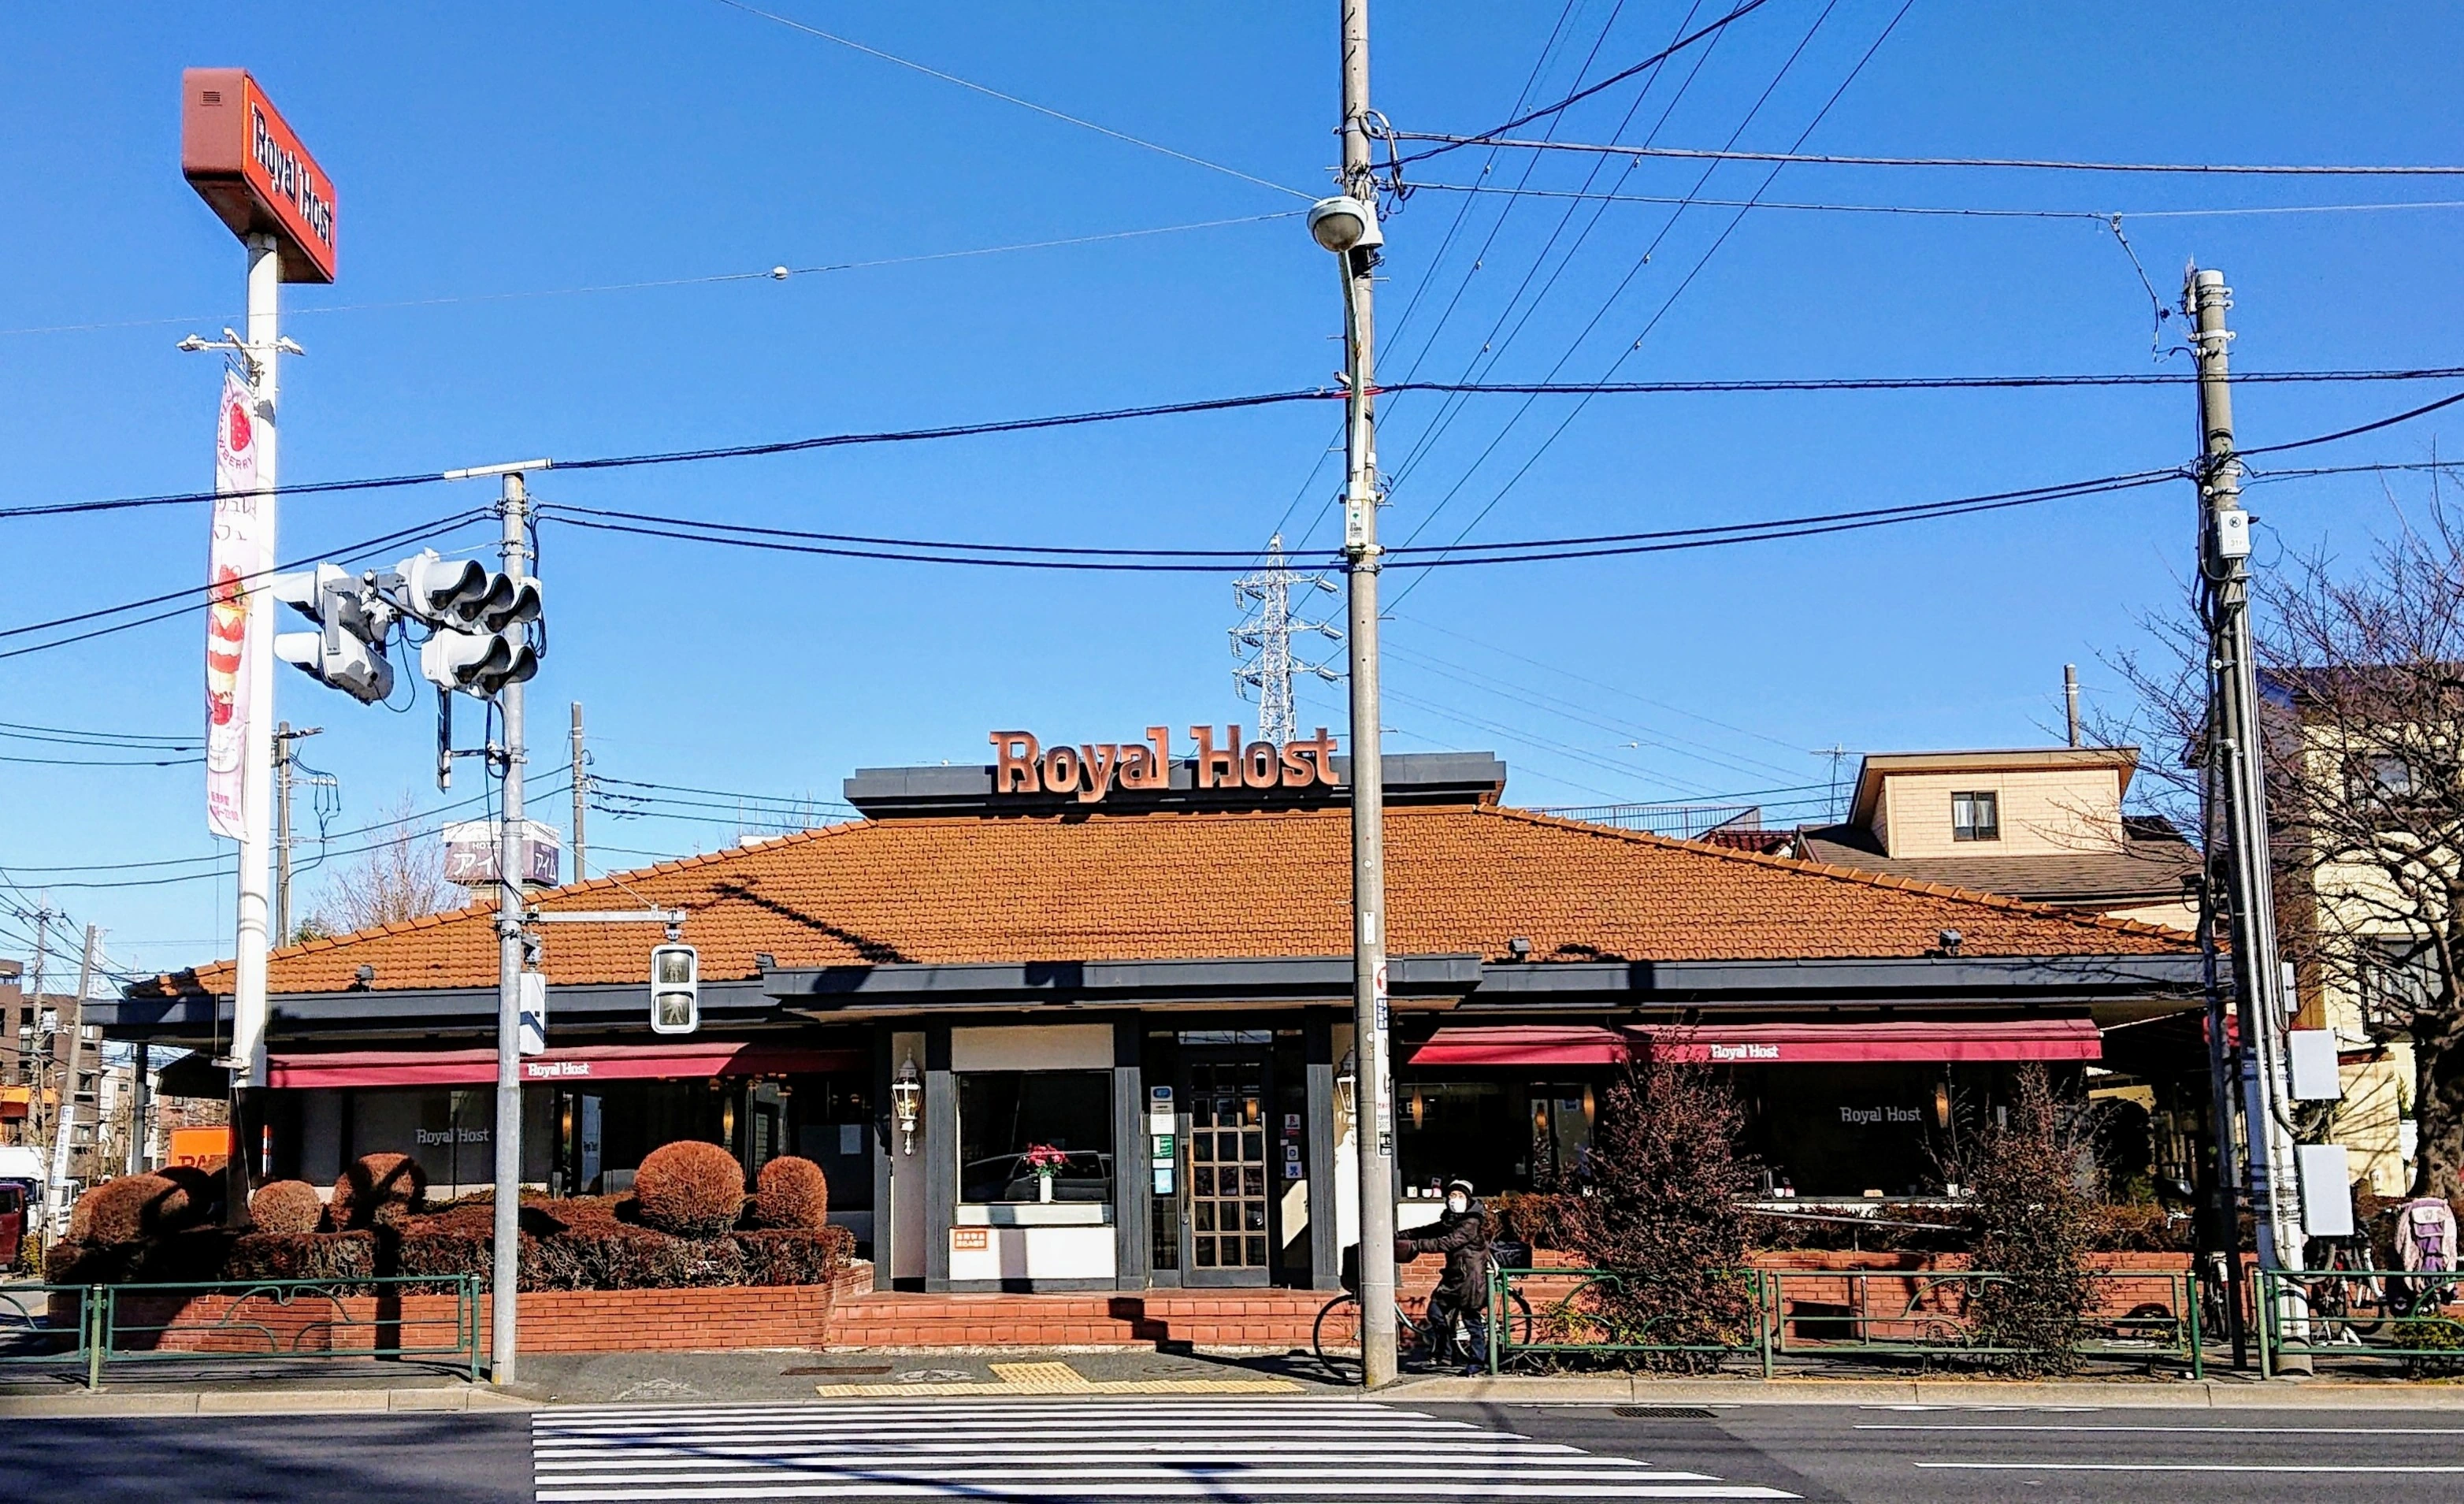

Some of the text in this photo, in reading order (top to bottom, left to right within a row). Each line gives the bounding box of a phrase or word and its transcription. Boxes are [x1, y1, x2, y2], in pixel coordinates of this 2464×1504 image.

[250, 101, 333, 251] Royal Host
[989, 725, 1339, 803] Royal Host
[1710, 1044, 1779, 1060] Royal Host
[527, 1062, 589, 1078] Royal Host
[1839, 1106, 1922, 1124] Royal Host
[416, 1127, 489, 1146] Royal Host
